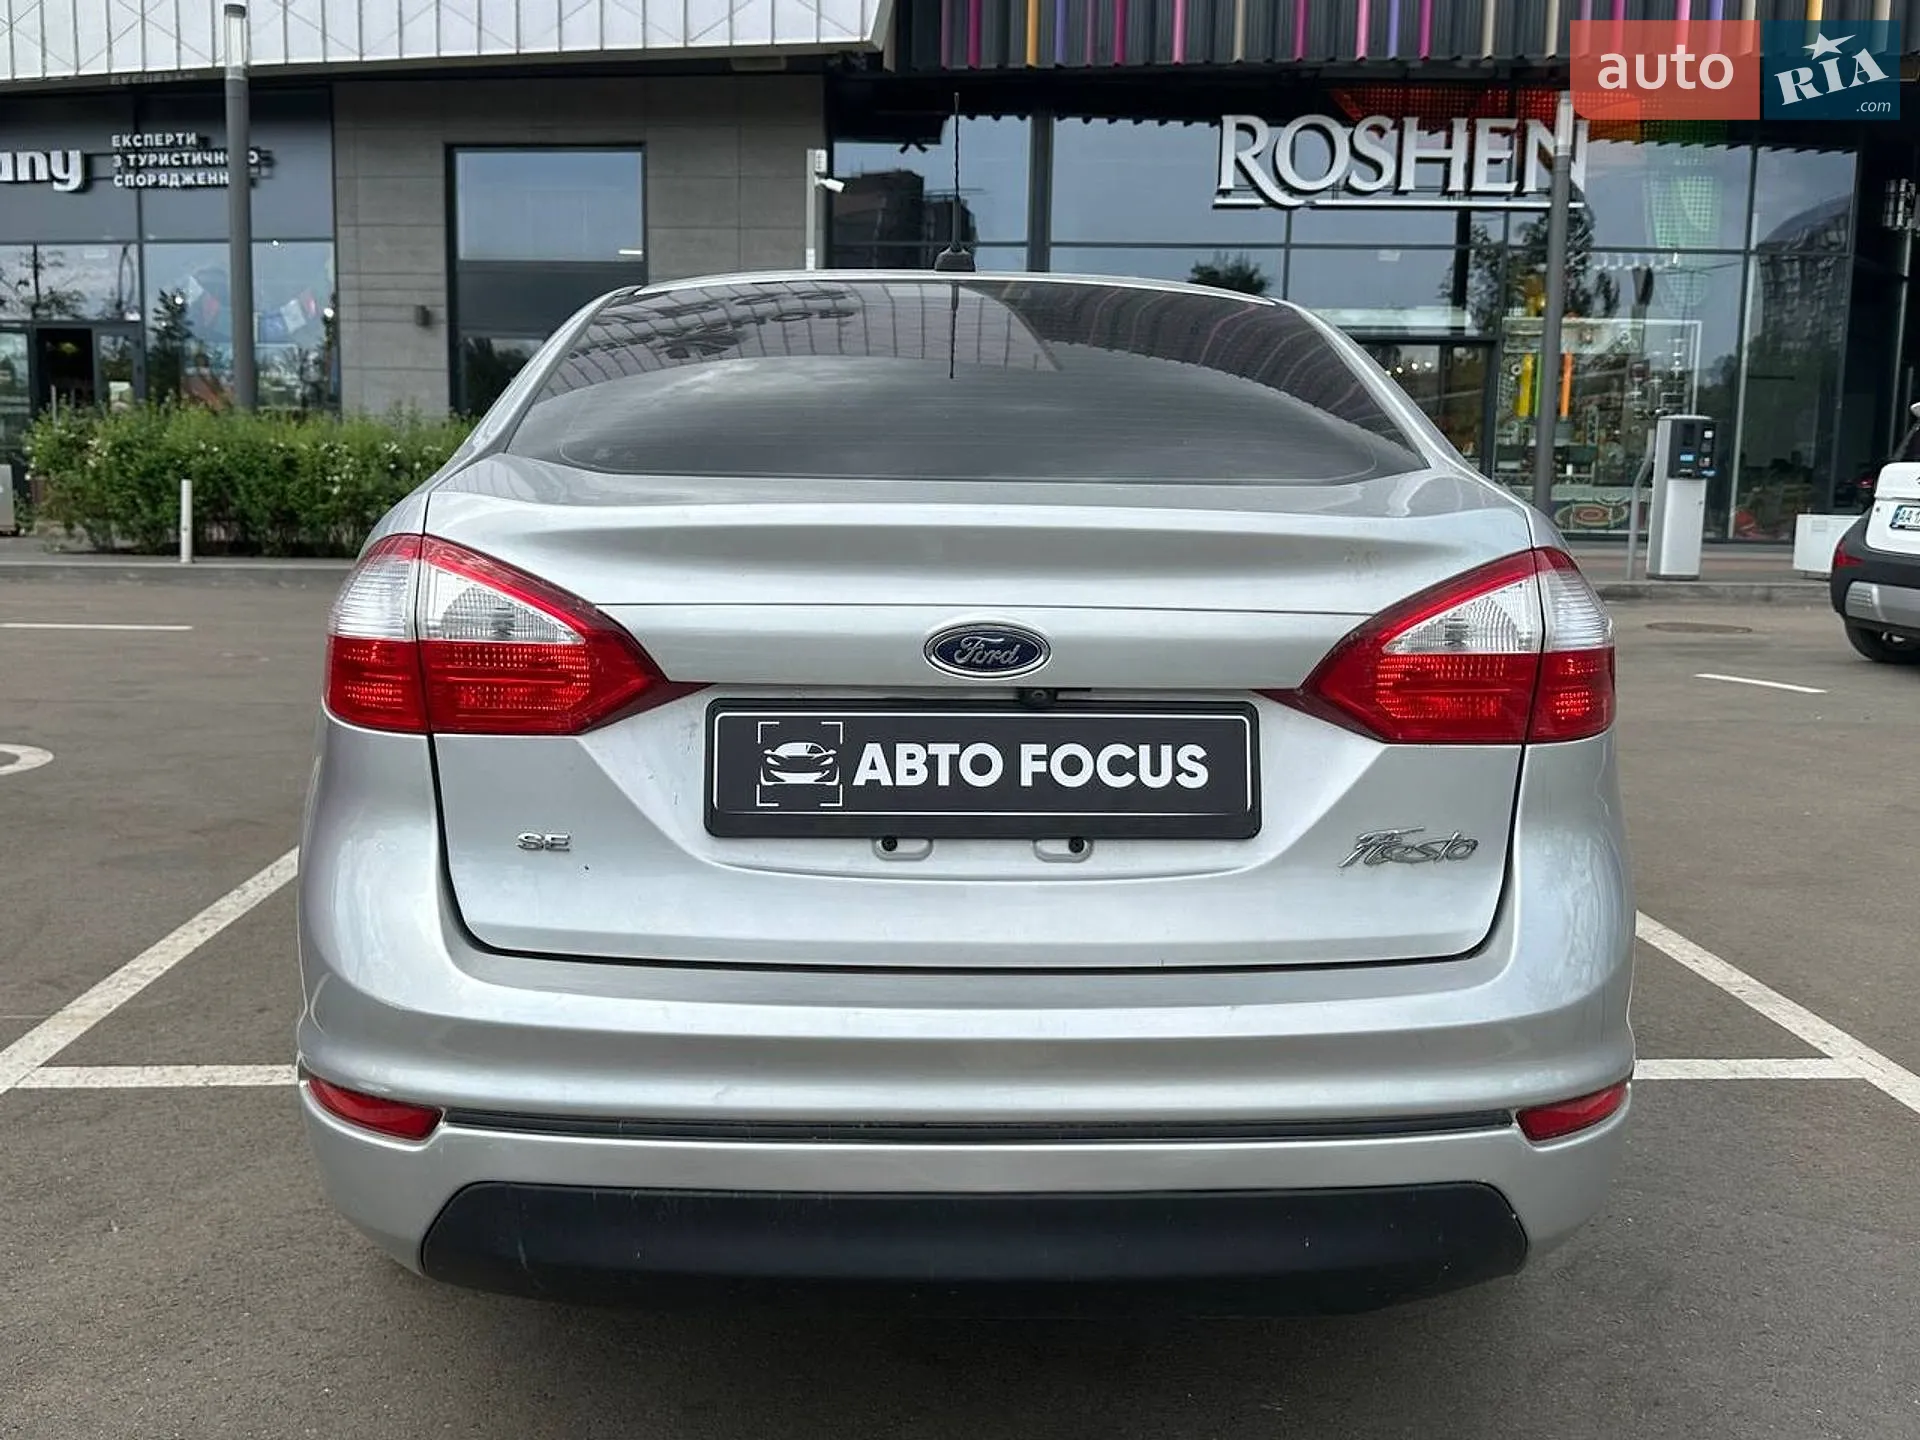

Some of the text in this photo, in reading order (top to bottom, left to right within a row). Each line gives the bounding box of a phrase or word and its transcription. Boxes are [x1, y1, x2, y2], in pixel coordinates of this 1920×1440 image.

[111, 133, 197, 148] ЕКСПЕРТИ
[127, 151, 258, 167] ТУРИСТИЧНО
[1219, 114, 1589, 206] ROSHEN
[113, 171, 230, 187] СПОРЯДЖЕНН
[954, 635, 1020, 664] Ford
[852, 742, 1209, 789] АВТО FOCUS
[516, 832, 571, 852] SE
